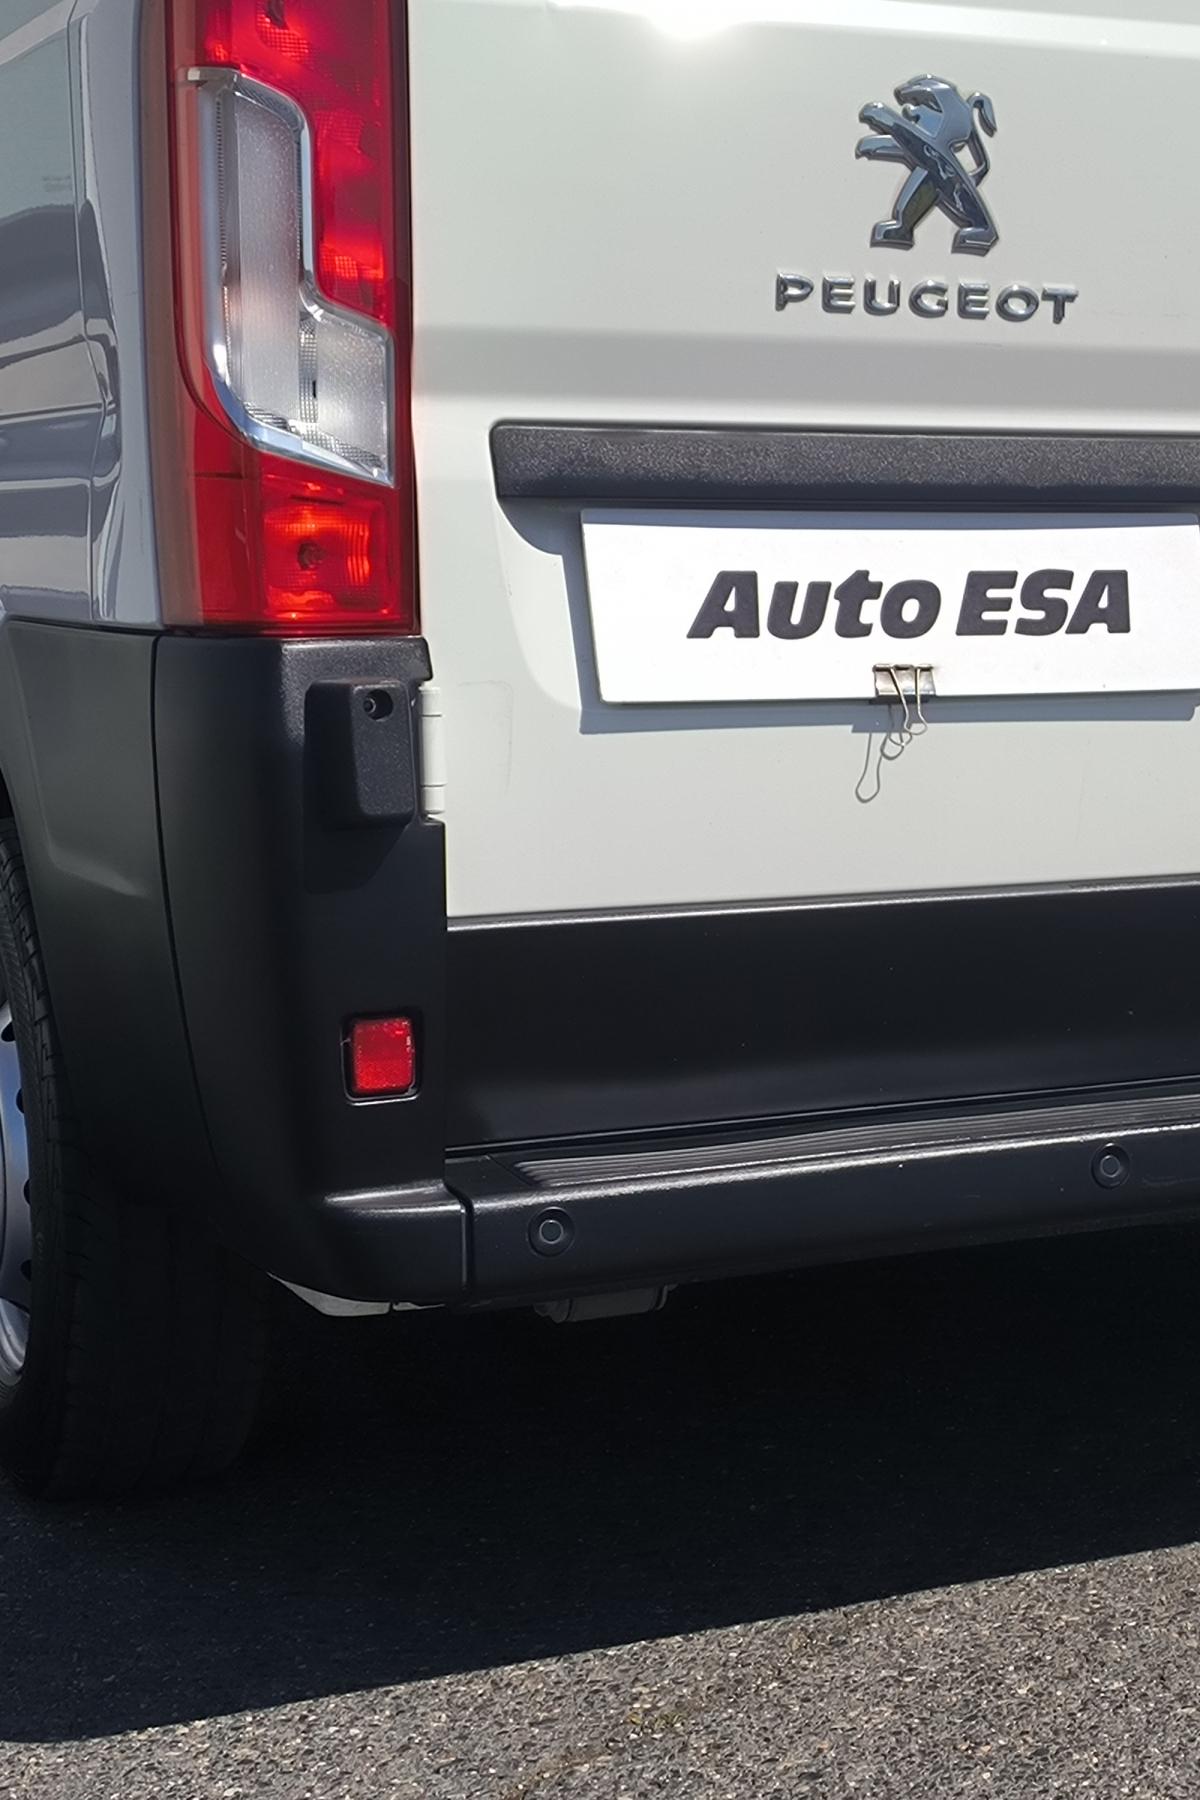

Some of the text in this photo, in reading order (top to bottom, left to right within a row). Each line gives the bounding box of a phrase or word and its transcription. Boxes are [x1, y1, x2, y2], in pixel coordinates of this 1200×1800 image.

[775, 272, 1079, 324] PEUGEOT
[686, 569, 1131, 640] Auto ESA
